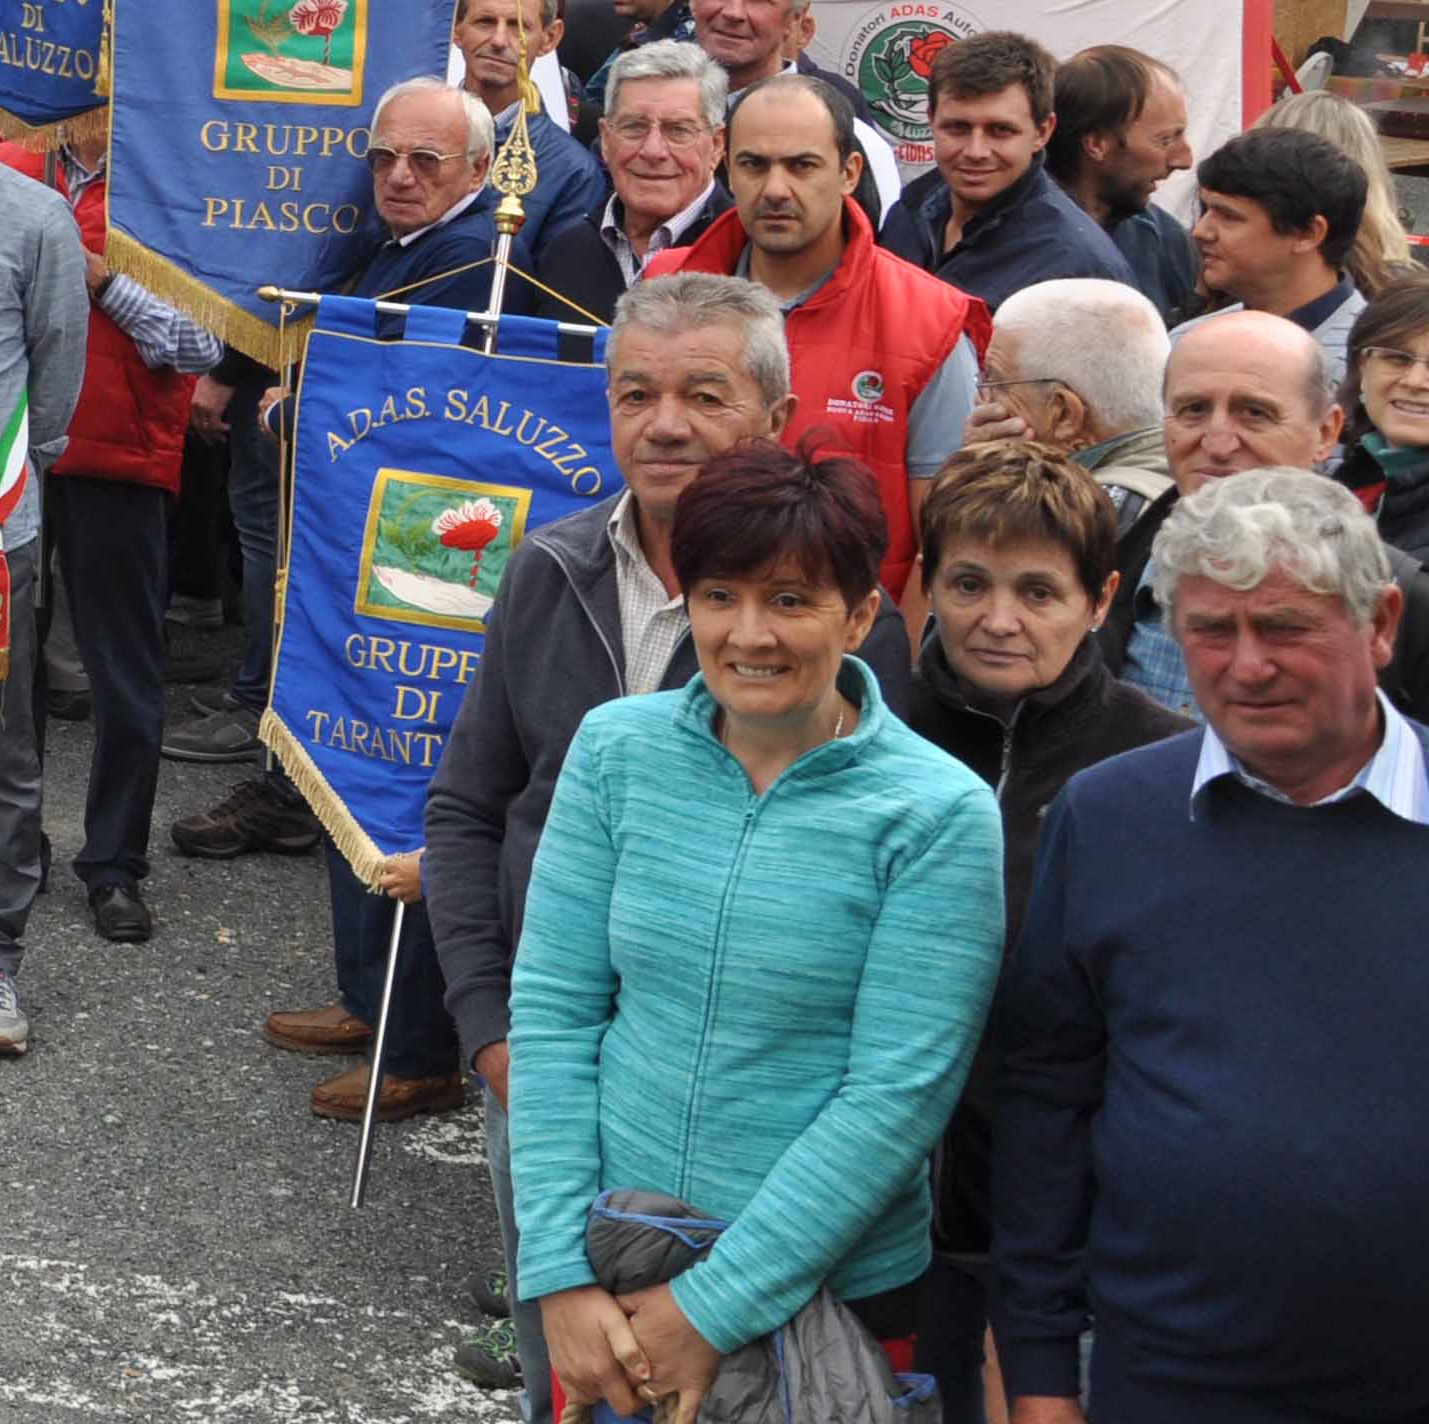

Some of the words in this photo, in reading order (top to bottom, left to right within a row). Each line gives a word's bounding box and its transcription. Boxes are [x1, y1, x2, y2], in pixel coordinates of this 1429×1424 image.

[21, 2, 46, 32] DI
[845, 13, 886, 77] Donatori
[890, 4, 939, 18] ADAS
[200, 120, 372, 160] GRUPPO
[267, 166, 303, 192] DI
[201, 198, 359, 234] PIASCO
[444, 389, 602, 496] SALUZZO
[345, 633, 482, 685] GRUPP
[393, 685, 444, 724] DI
[306, 709, 444, 767] TARANT
